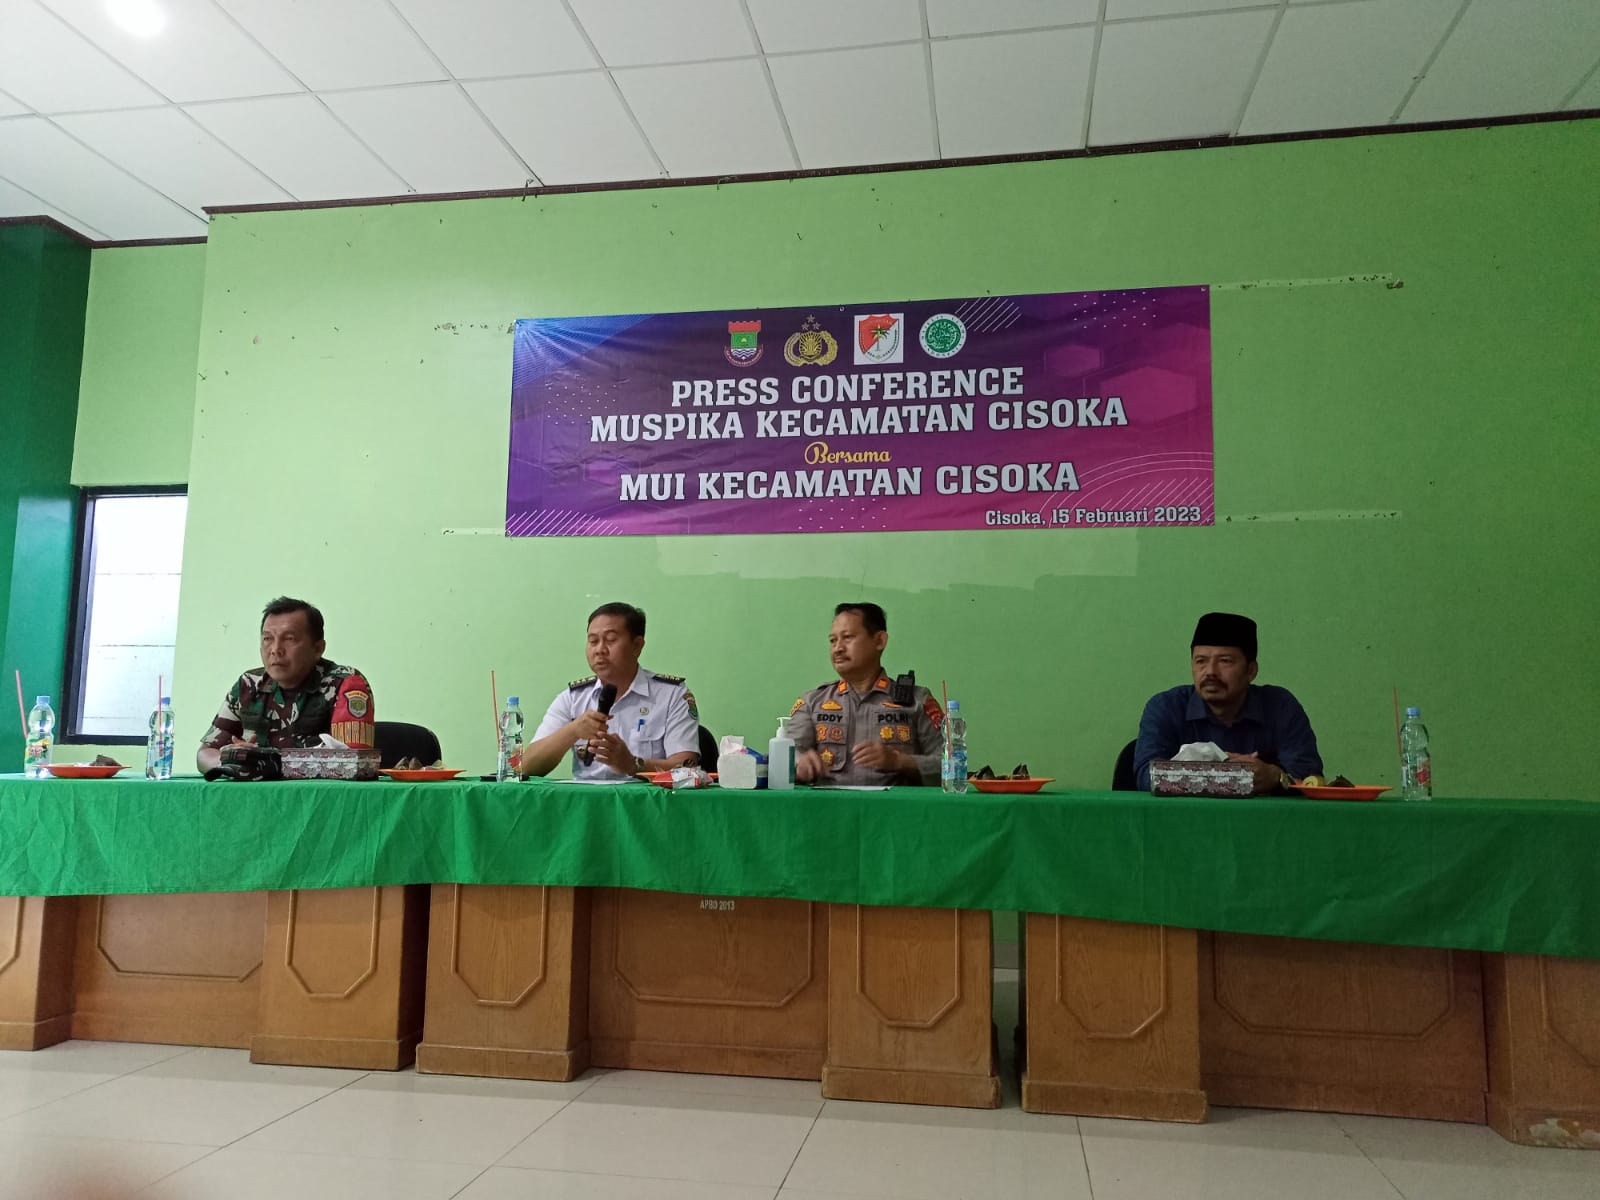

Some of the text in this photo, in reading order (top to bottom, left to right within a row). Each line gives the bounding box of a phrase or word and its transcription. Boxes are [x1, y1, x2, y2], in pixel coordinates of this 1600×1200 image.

[671, 366, 1024, 408] PRESS CONFERENCE
[590, 396, 1128, 443] MUSPIKA KECAMATAN CISOKA
[804, 441, 892, 465] Bersama
[618, 462, 1080, 502] MUI KECAMATAN CISOKA
[985, 505, 1202, 527] Cisoka, 15 Februari 2023
[816, 714, 844, 723] EDDY
[877, 714, 909, 724] POLRI
[718, 900, 736, 911] 2013
